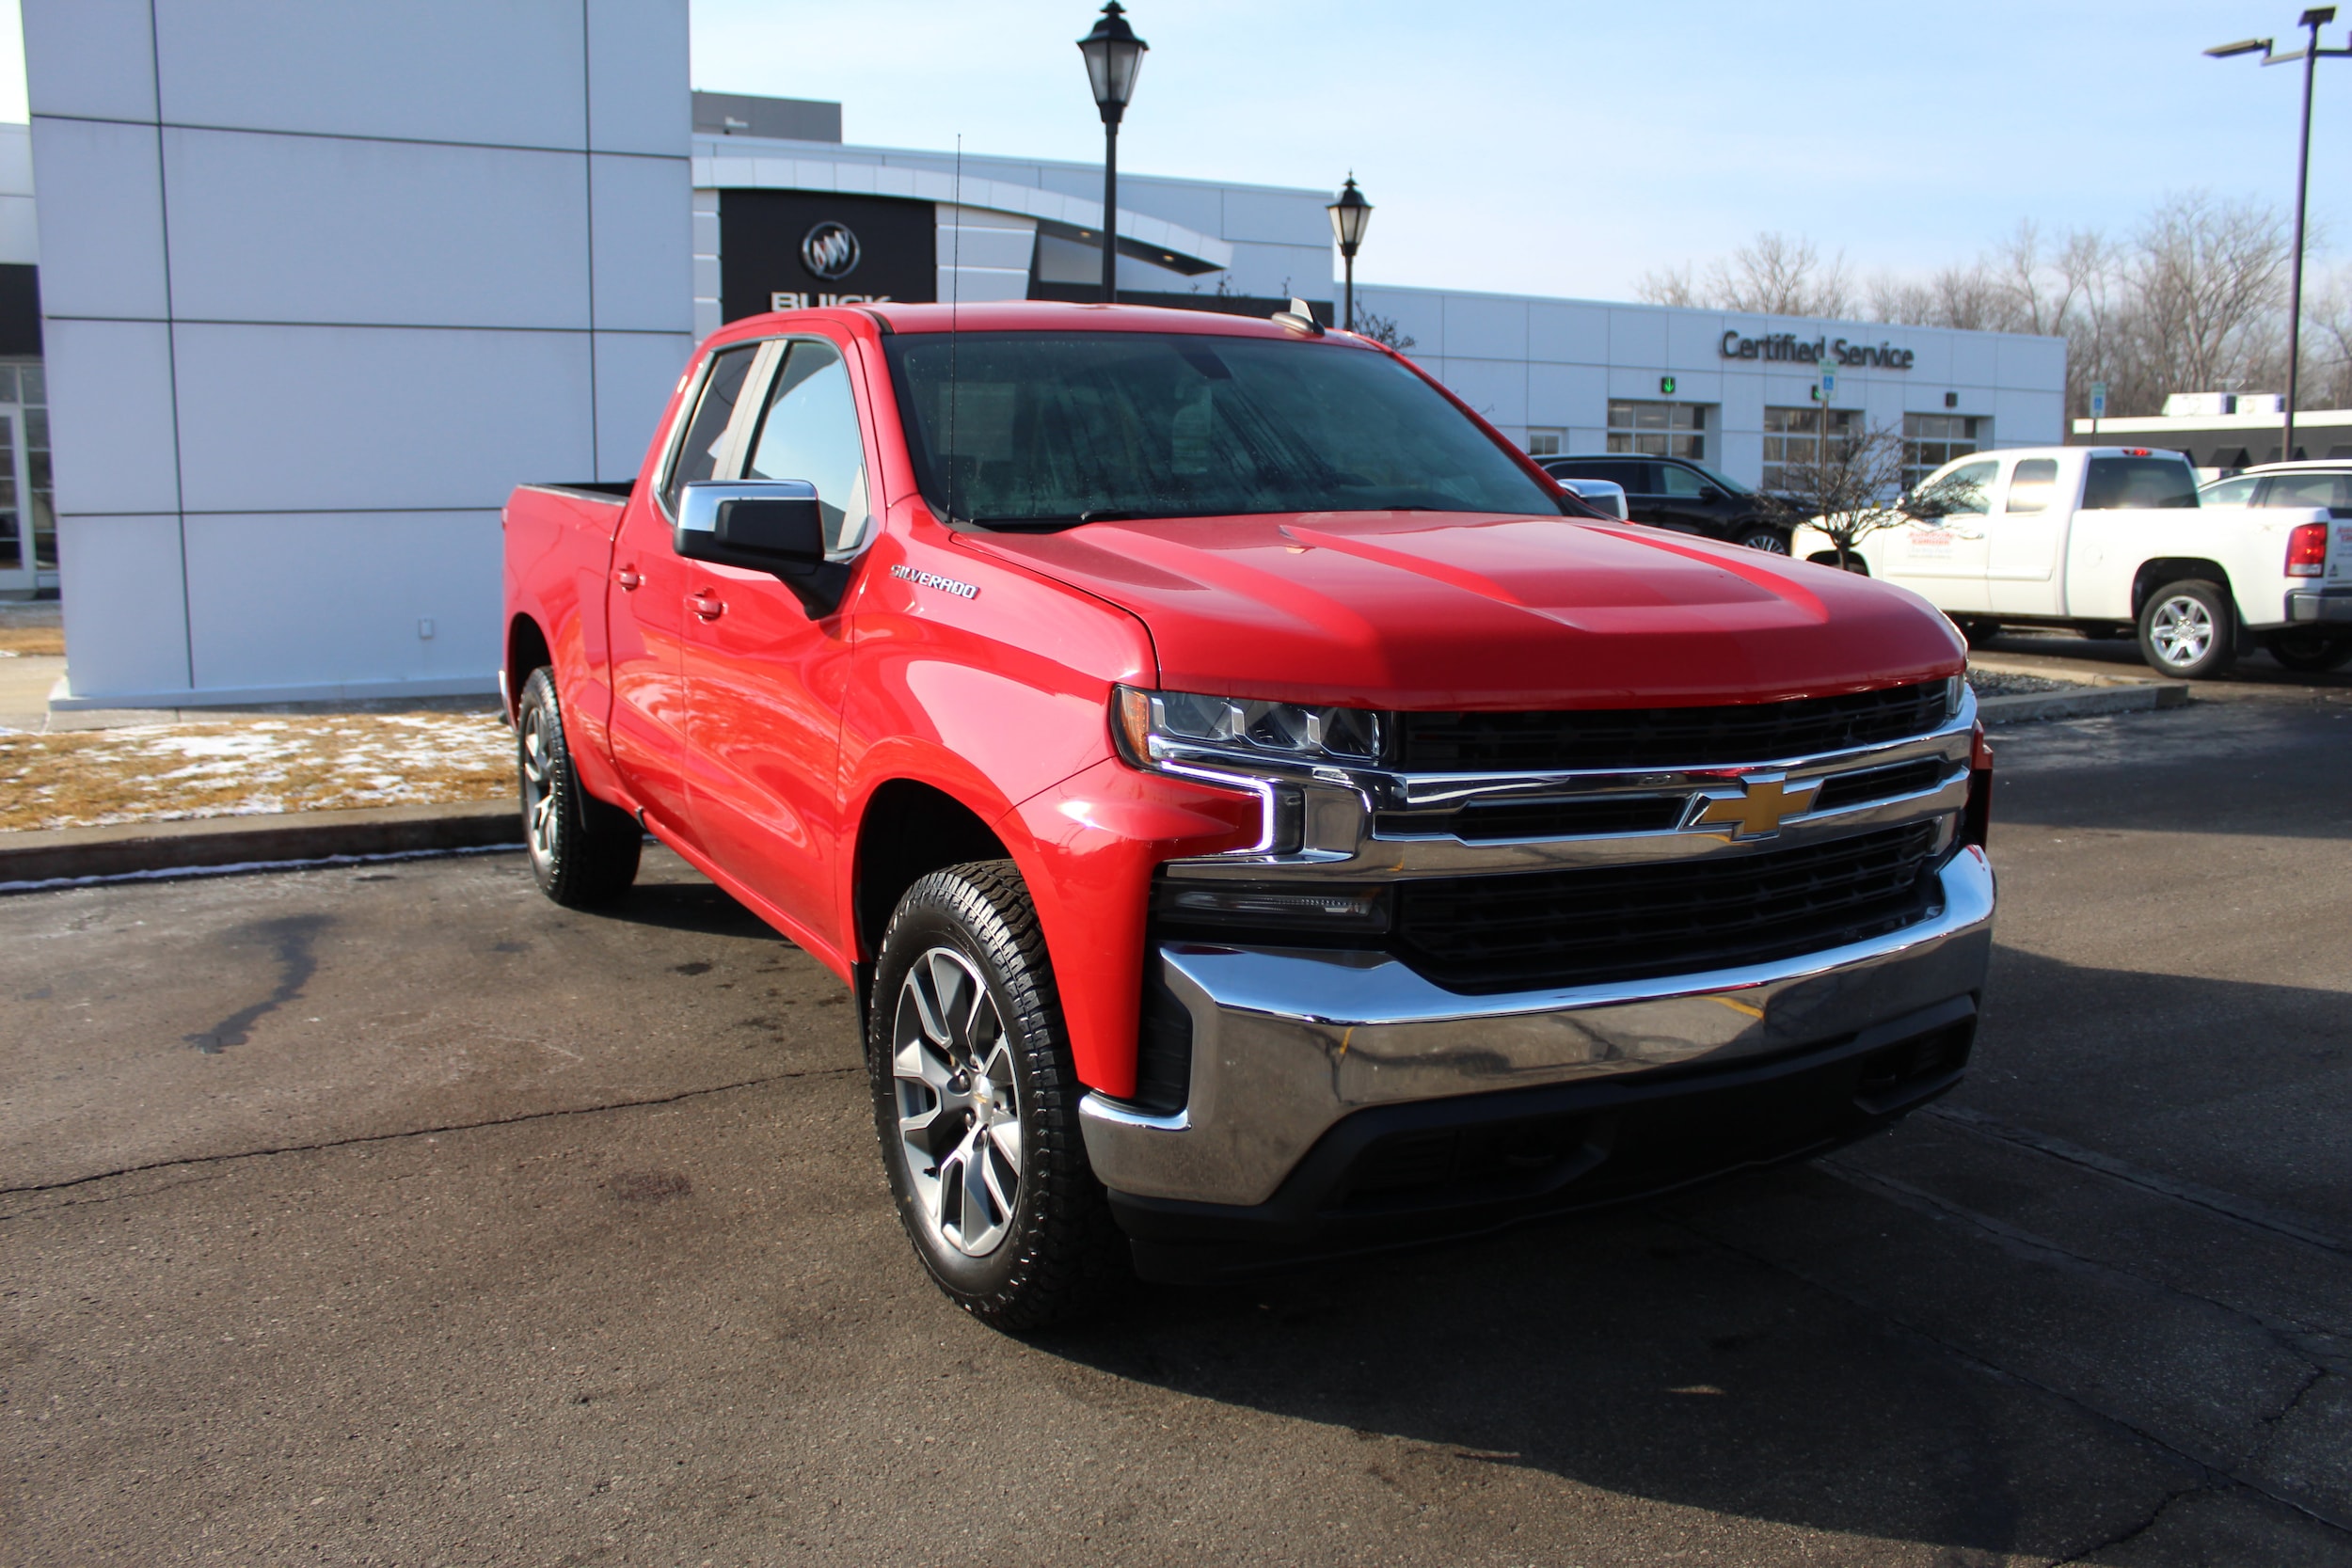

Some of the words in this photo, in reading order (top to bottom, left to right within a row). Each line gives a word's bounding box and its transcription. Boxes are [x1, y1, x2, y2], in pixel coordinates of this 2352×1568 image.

[1721, 330, 1826, 363] Certified
[1832, 338, 1915, 369] Service
[890, 564, 979, 600] SILVERADO
